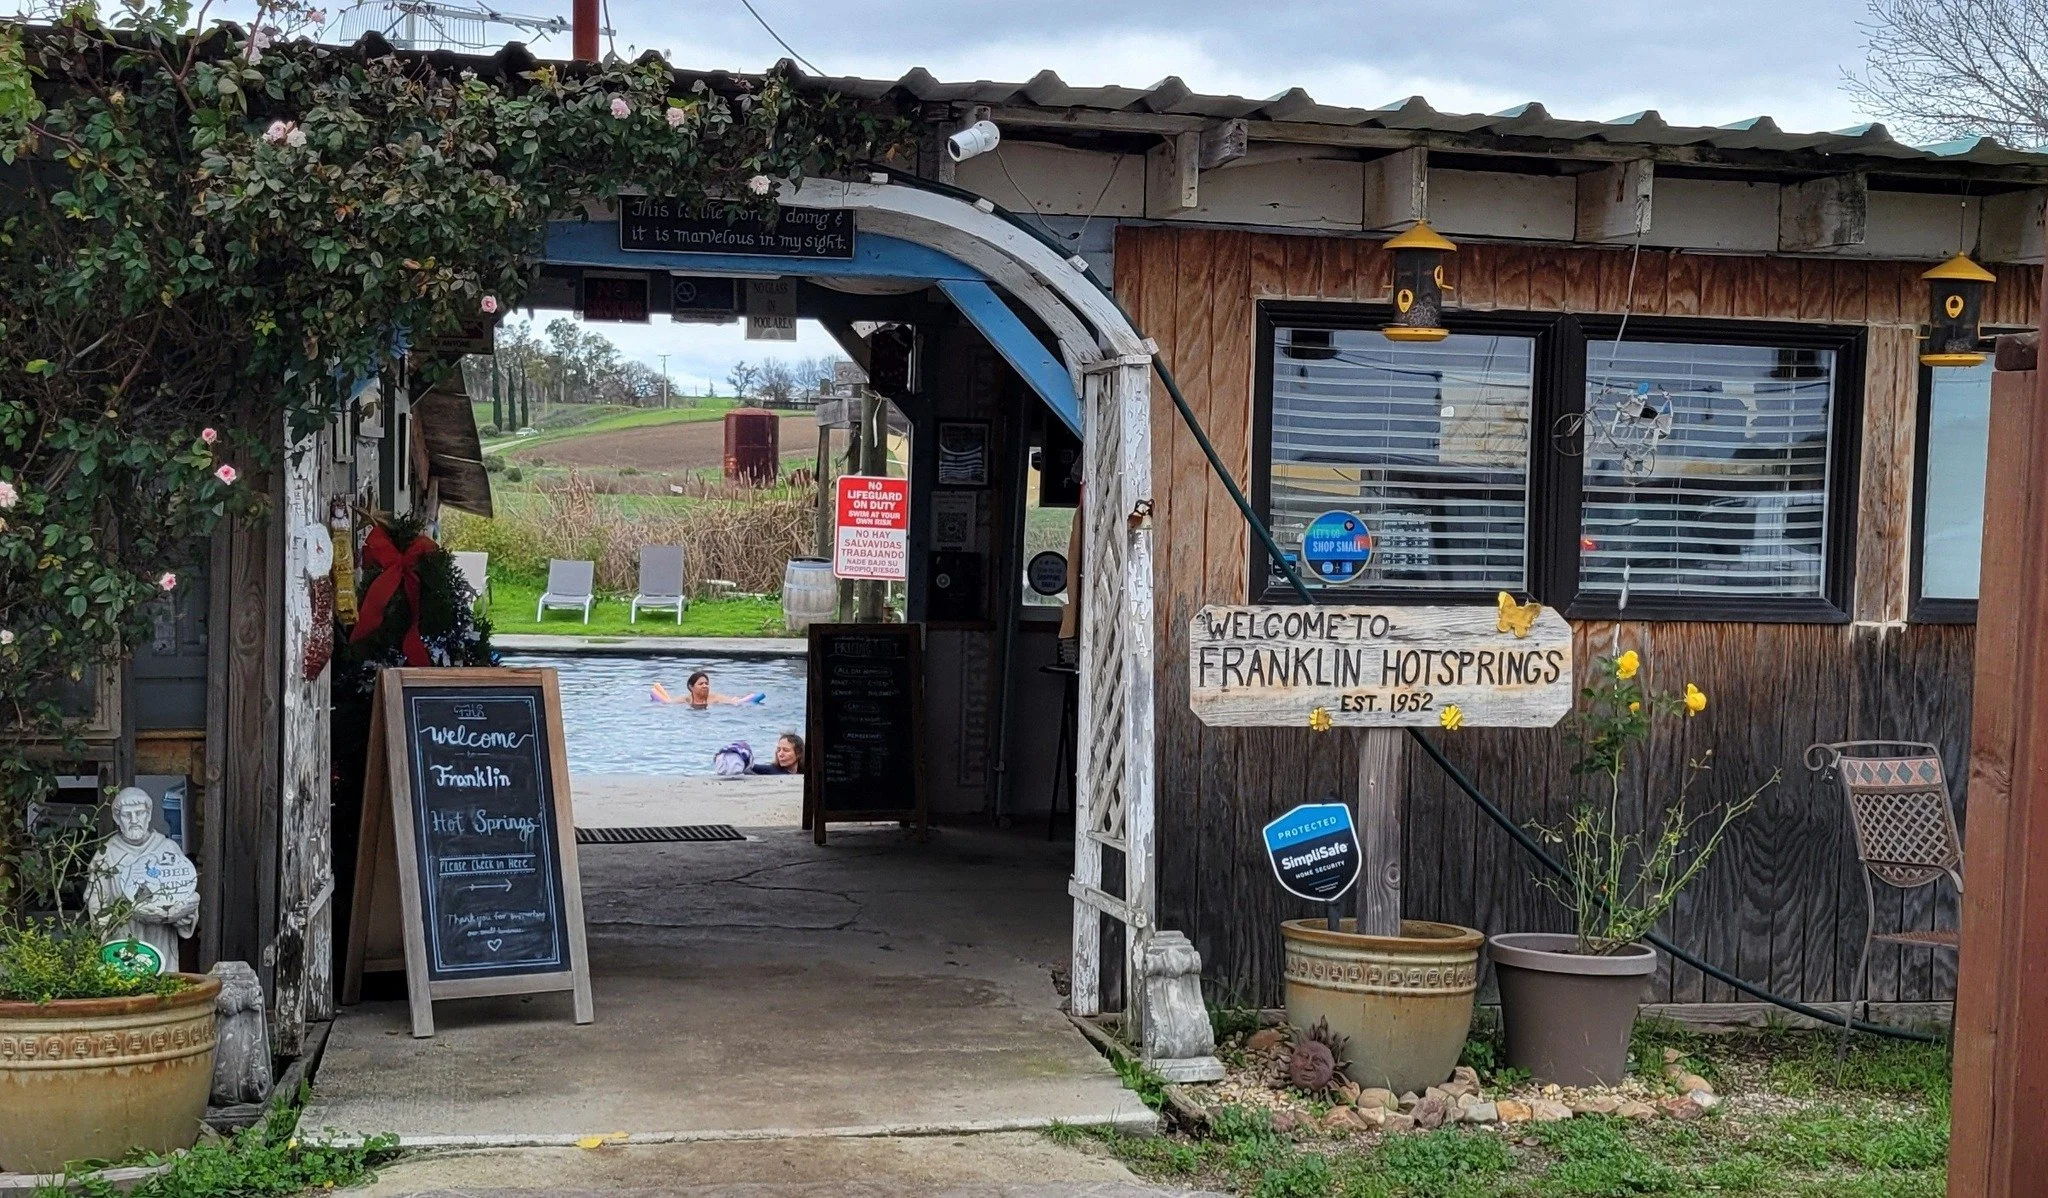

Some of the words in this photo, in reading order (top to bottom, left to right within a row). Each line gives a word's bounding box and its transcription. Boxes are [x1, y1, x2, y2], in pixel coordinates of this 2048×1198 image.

[632, 200, 669, 218] This
[786, 210, 830, 231] doing
[836, 211, 843, 228] &
[632, 226, 648, 241] it
[655, 227, 670, 242] is
[674, 228, 755, 246] marvelous
[759, 232, 775, 247] in
[779, 235, 801, 253] my
[804, 234, 848, 255] sight.
[753, 282, 764, 294] NO
[765, 282, 788, 294] GLASS
[753, 316, 772, 328] POOL
[773, 317, 793, 328] AREA
[868, 481, 882, 490] NO
[847, 490, 902, 501] LIFEGUARD
[853, 500, 868, 509] ON
[869, 501, 897, 511] DUTY
[848, 510, 870, 518] SWIM
[881, 512, 901, 520] YOUR
[855, 518, 873, 526] OWN
[855, 530, 869, 538] NO
[872, 530, 891, 539] HAY
[1312, 529, 1329, 539] LET'S
[1331, 529, 1341, 539] GO
[844, 538, 902, 550] SALVAVIDAS
[1312, 540, 1335, 552] SHOP
[1336, 540, 1363, 552] SMALL
[841, 548, 905, 559] TRABAJANDO
[846, 558, 867, 566] NADE
[868, 559, 887, 567] BAJO
[844, 565, 871, 573] PROPIO
[872, 566, 900, 574] RIESGO
[1198, 611, 1347, 640] WELCOME
[1350, 613, 1390, 640] TO
[1199, 646, 1363, 688] FRANKLIN
[1381, 649, 1565, 686] HOTSPRINGS
[1340, 694, 1383, 713] EST.
[1389, 692, 1434, 713] 1952
[430, 765, 511, 788] Franklin
[431, 810, 465, 833] Hot
[474, 808, 540, 842] Springs
[1277, 816, 1337, 840] PROTECTED
[1281, 842, 1348, 870] SimpliSafe
[496, 860, 504, 870] in
[1295, 869, 1314, 880] HOME
[1314, 860, 1345, 874] SECURITY
[161, 867, 190, 878] BEE
[447, 912, 475, 926] Thank
[476, 914, 492, 927] you
[494, 911, 507, 920] for
